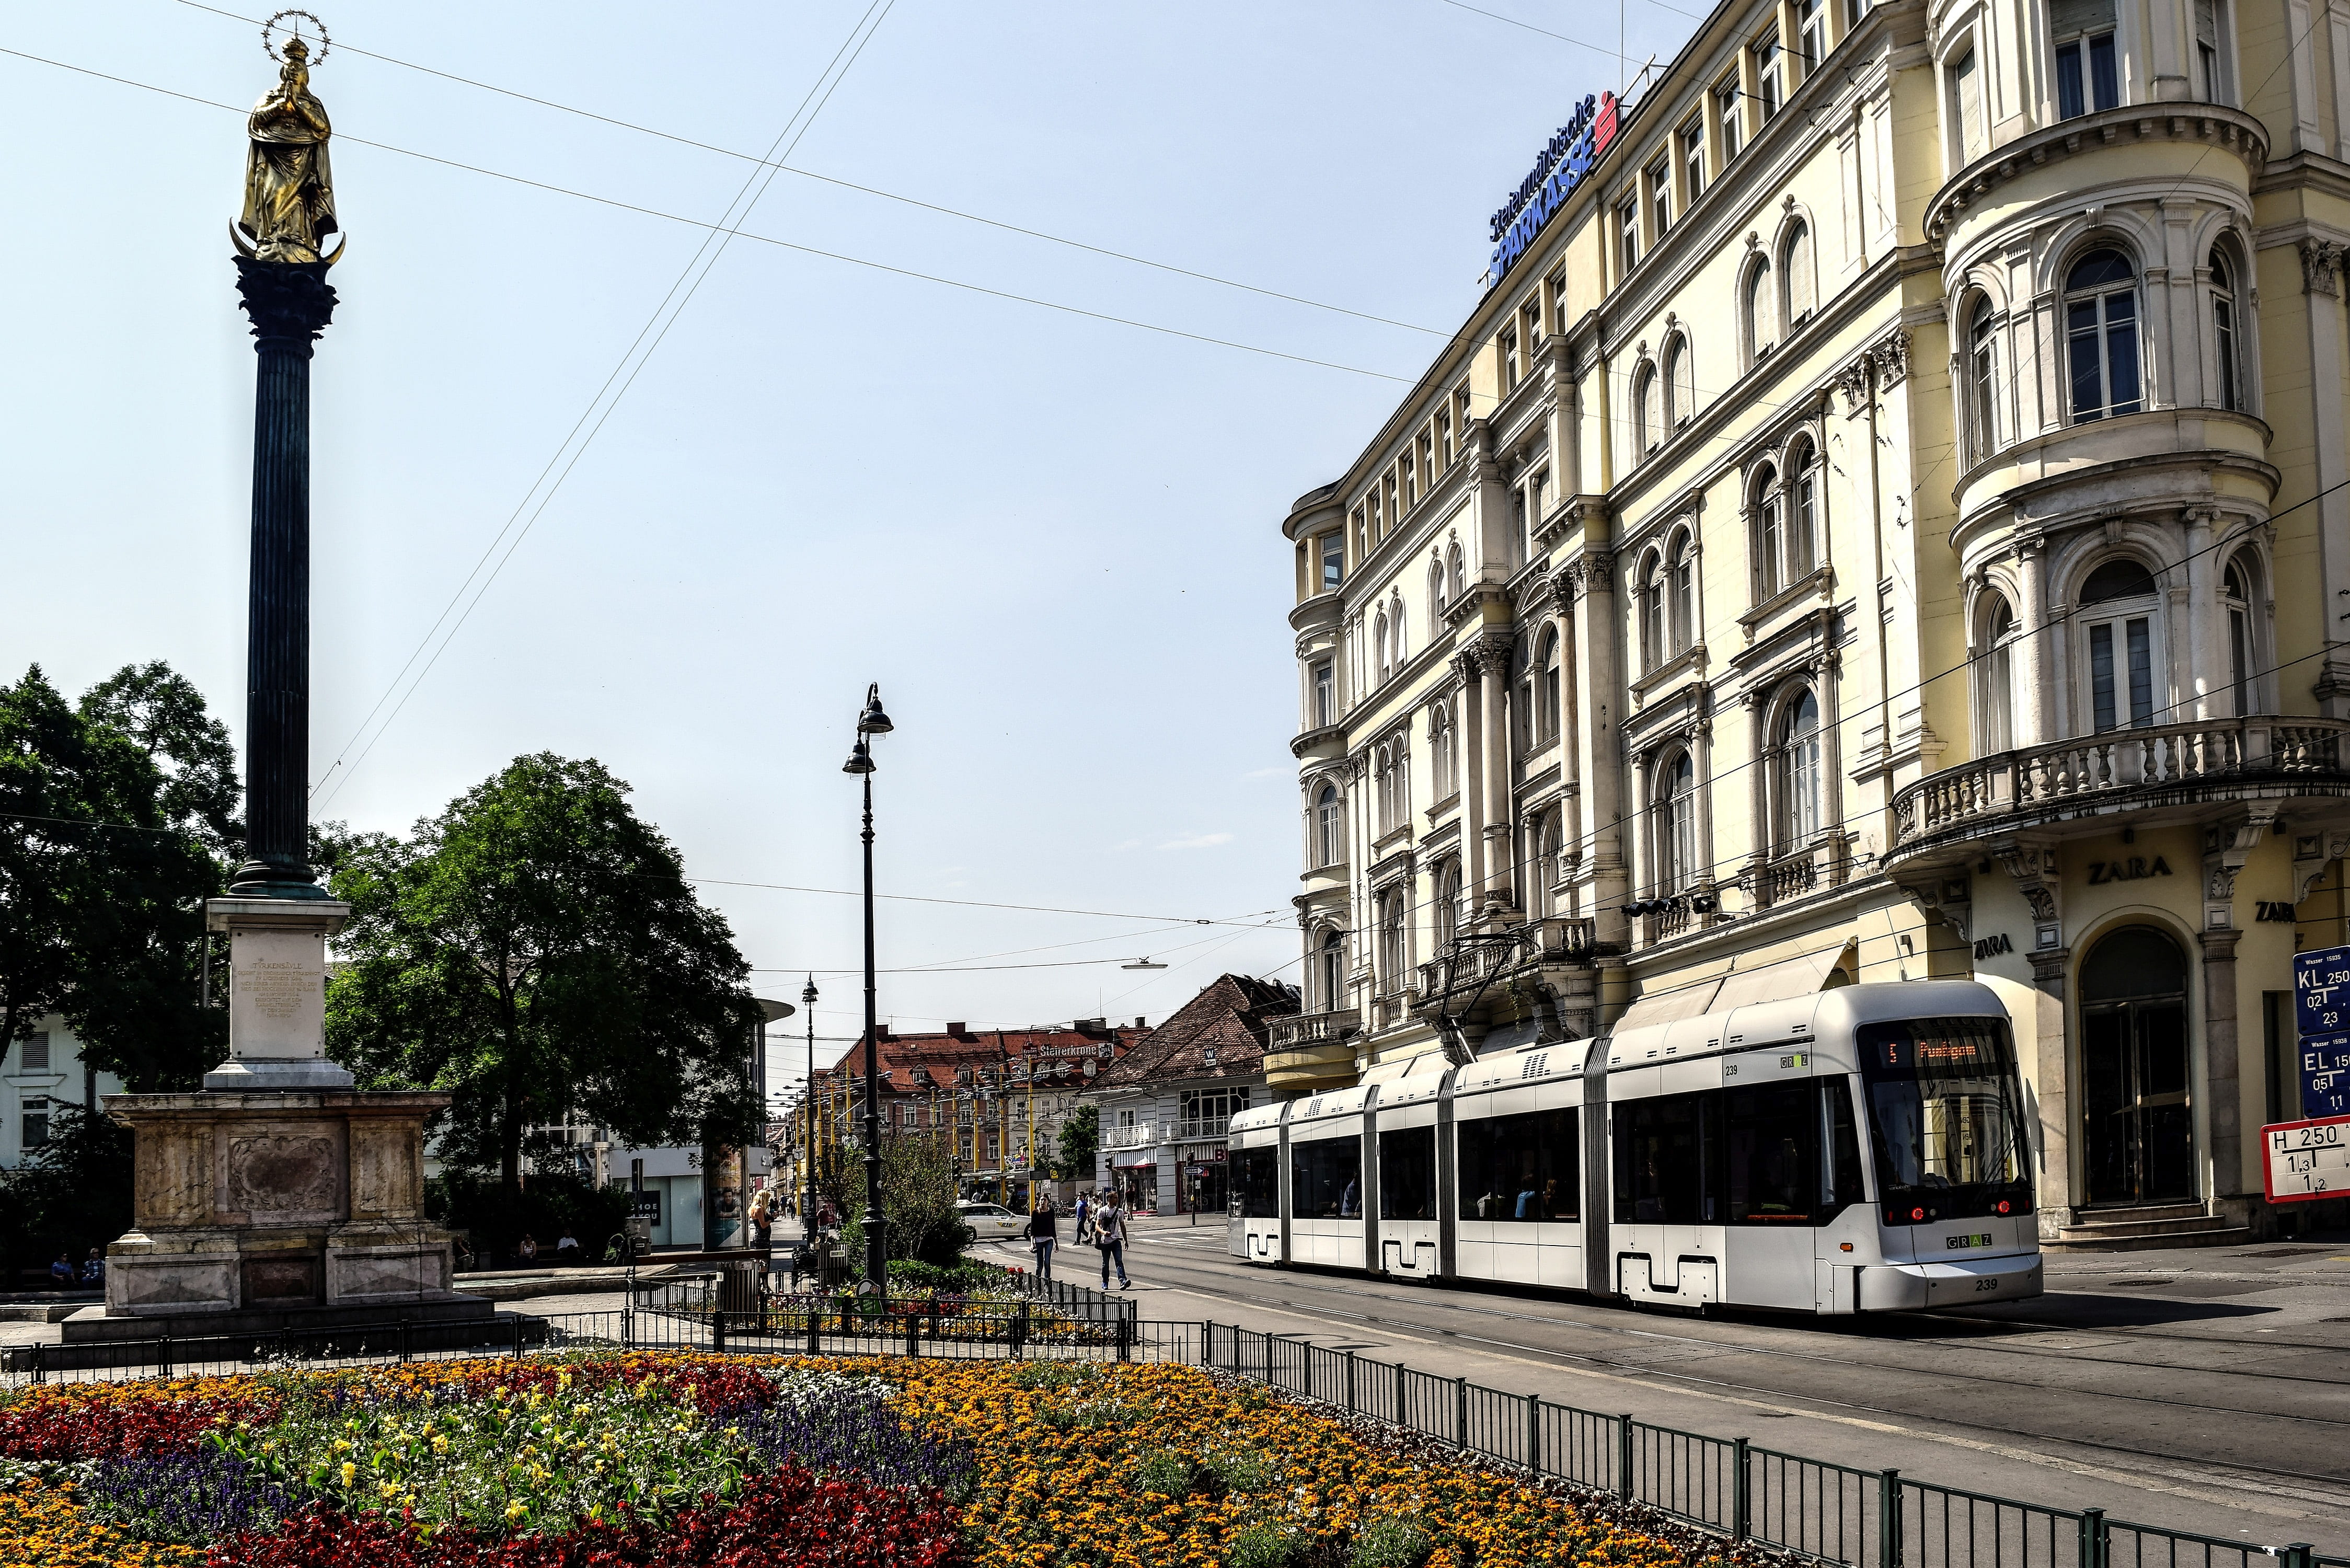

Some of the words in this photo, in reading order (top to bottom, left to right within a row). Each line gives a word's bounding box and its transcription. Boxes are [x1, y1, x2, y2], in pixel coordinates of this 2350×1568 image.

[1489, 93, 1595, 242] Steiermärkische
[1490, 125, 1596, 287] SPARKASSE
[2089, 856, 2173, 884] ZARA
[2255, 901, 2297, 923] ZARA
[1974, 933, 2013, 960] ZARA
[2298, 970, 2322, 989] KL
[2328, 970, 2349, 984] 250
[1041, 1045, 1097, 1056] Steirerkrone
[1205, 1050, 1214, 1058] W
[1890, 1044, 1897, 1063] 5
[1726, 1065, 1738, 1076] 239
[1781, 1055, 1807, 1068] GRAZ
[2304, 1052, 2329, 1071] EL
[2274, 1132, 2287, 1149] H
[2300, 1126, 2337, 1146] 250
[1948, 1235, 1991, 1248] GRAZ
[1975, 1278, 1998, 1292] 239
